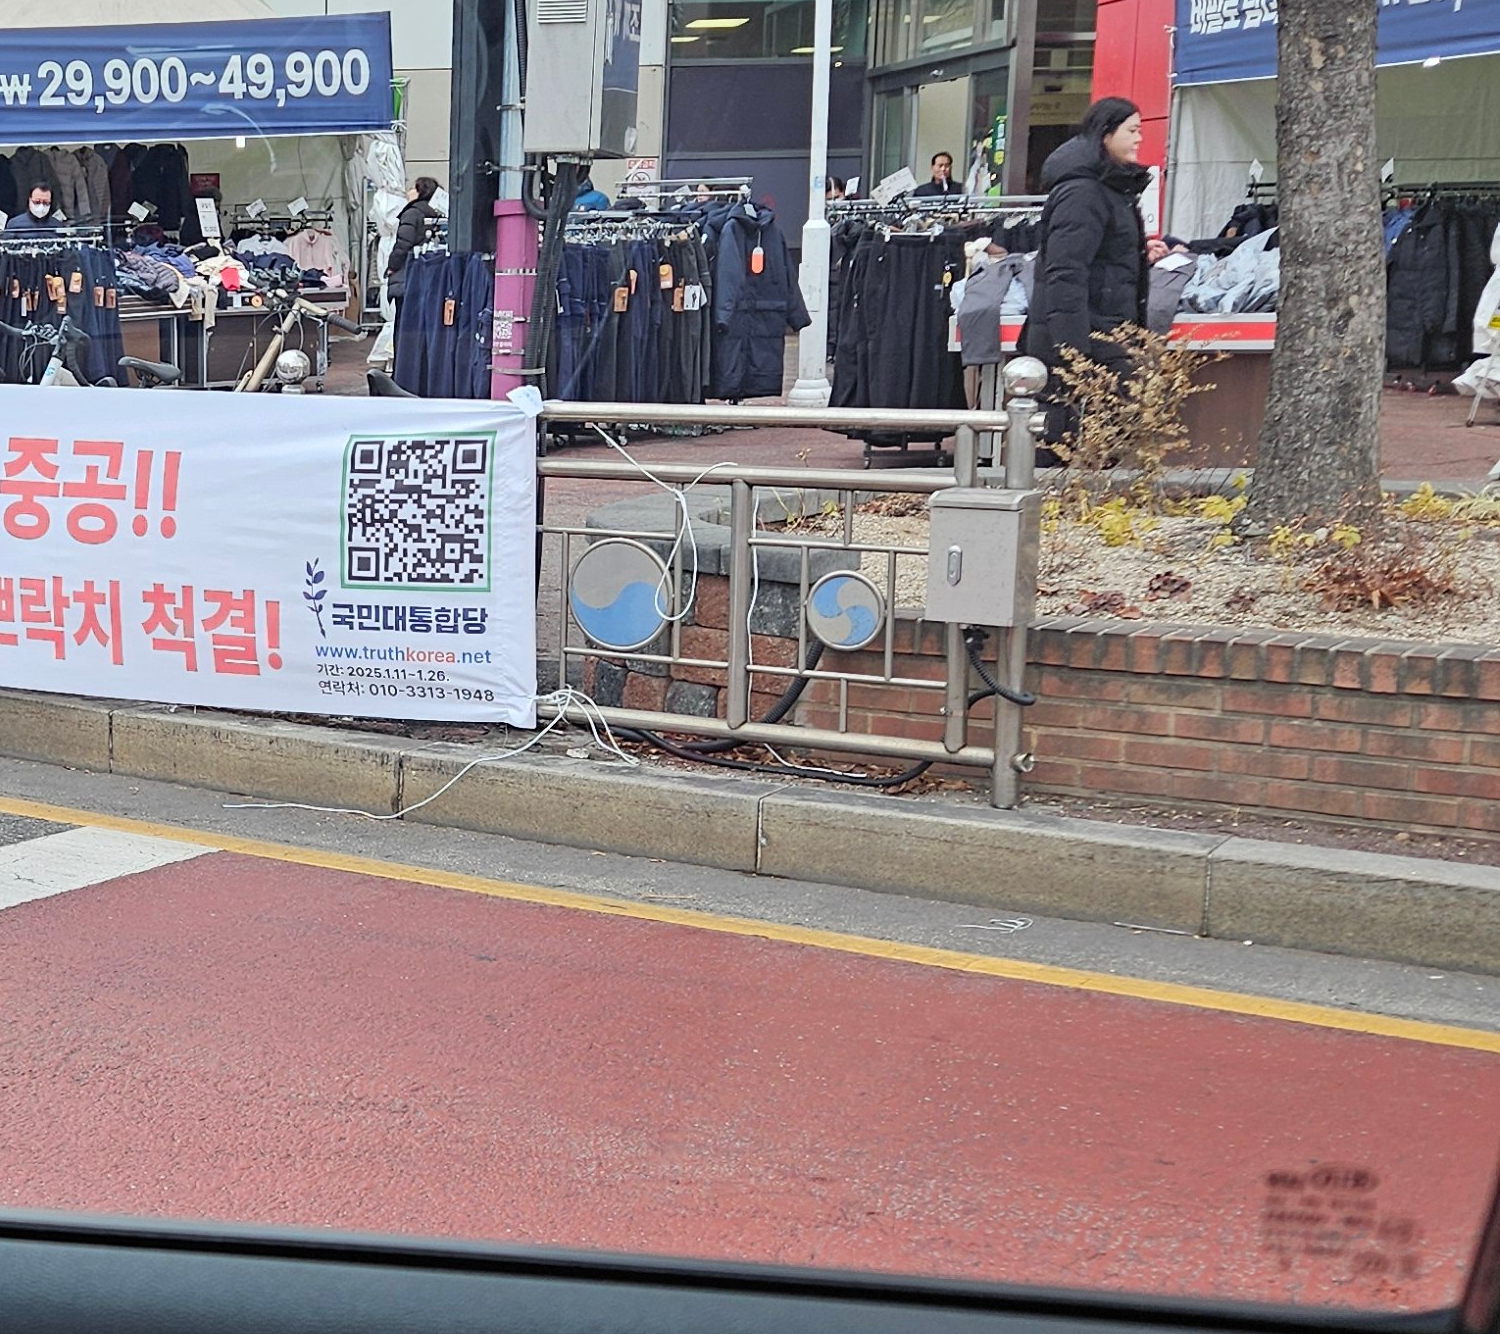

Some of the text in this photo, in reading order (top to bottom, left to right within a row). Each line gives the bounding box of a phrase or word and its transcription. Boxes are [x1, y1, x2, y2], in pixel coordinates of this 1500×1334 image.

[0, 437, 183, 544] 중공!!
[141, 583, 283, 676] 척결!
[332, 603, 488, 634] 국민대통합당
[315, 645, 492, 664] www.truthkorea.net
[317, 664, 344, 677] 기간:
[318, 680, 494, 701] 연락처: 010-3313-1948
